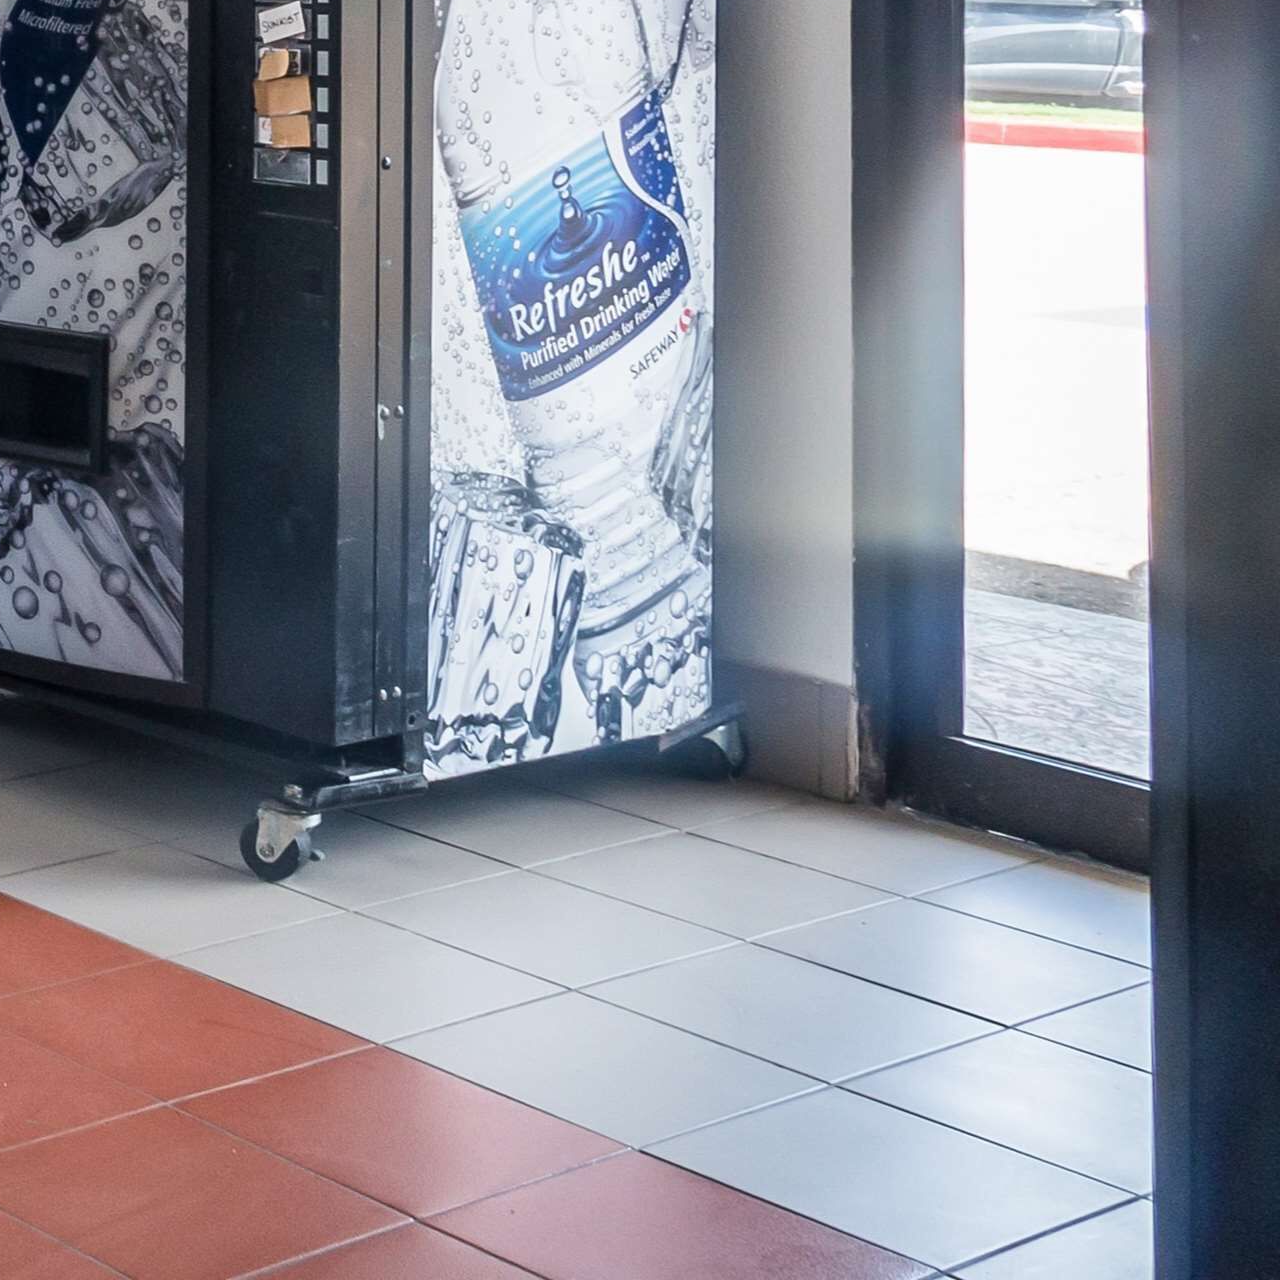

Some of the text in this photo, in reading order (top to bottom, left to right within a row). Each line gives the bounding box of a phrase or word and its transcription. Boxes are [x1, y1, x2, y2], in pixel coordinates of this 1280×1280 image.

[17, 9, 95, 35] Microfiltered
[509, 239, 638, 342] Refreshe
[520, 247, 682, 371] Purified Drinking Water
[528, 287, 672, 390] Enhanced with Minerals for Fresh Taste
[629, 328, 680, 380] SAFEWAY
